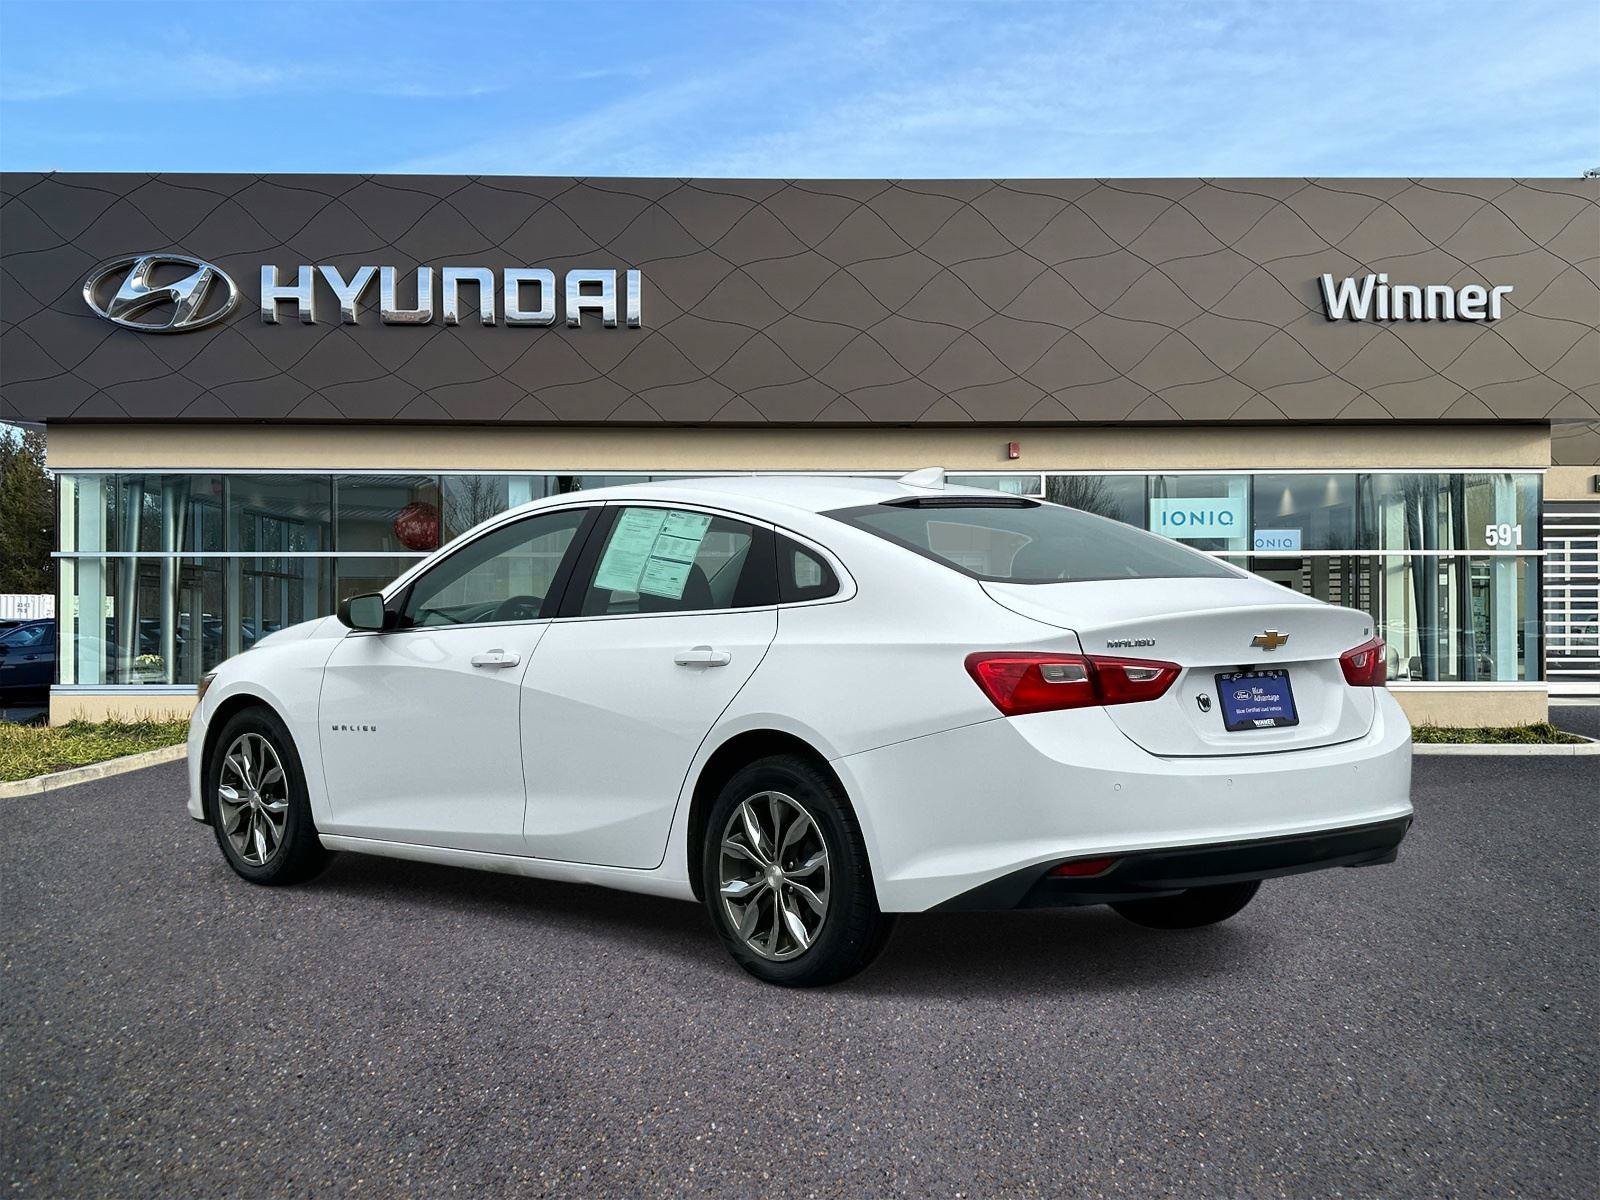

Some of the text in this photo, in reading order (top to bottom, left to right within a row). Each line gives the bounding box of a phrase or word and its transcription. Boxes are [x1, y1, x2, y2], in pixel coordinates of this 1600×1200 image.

[260, 265, 642, 329] HYUNDAI
[1321, 273, 1513, 321] Winner
[1162, 510, 1233, 526] IONIQ
[1255, 538, 1293, 548] ONIQ
[1485, 524, 1522, 546] 591
[1107, 638, 1156, 648] MALIBU
